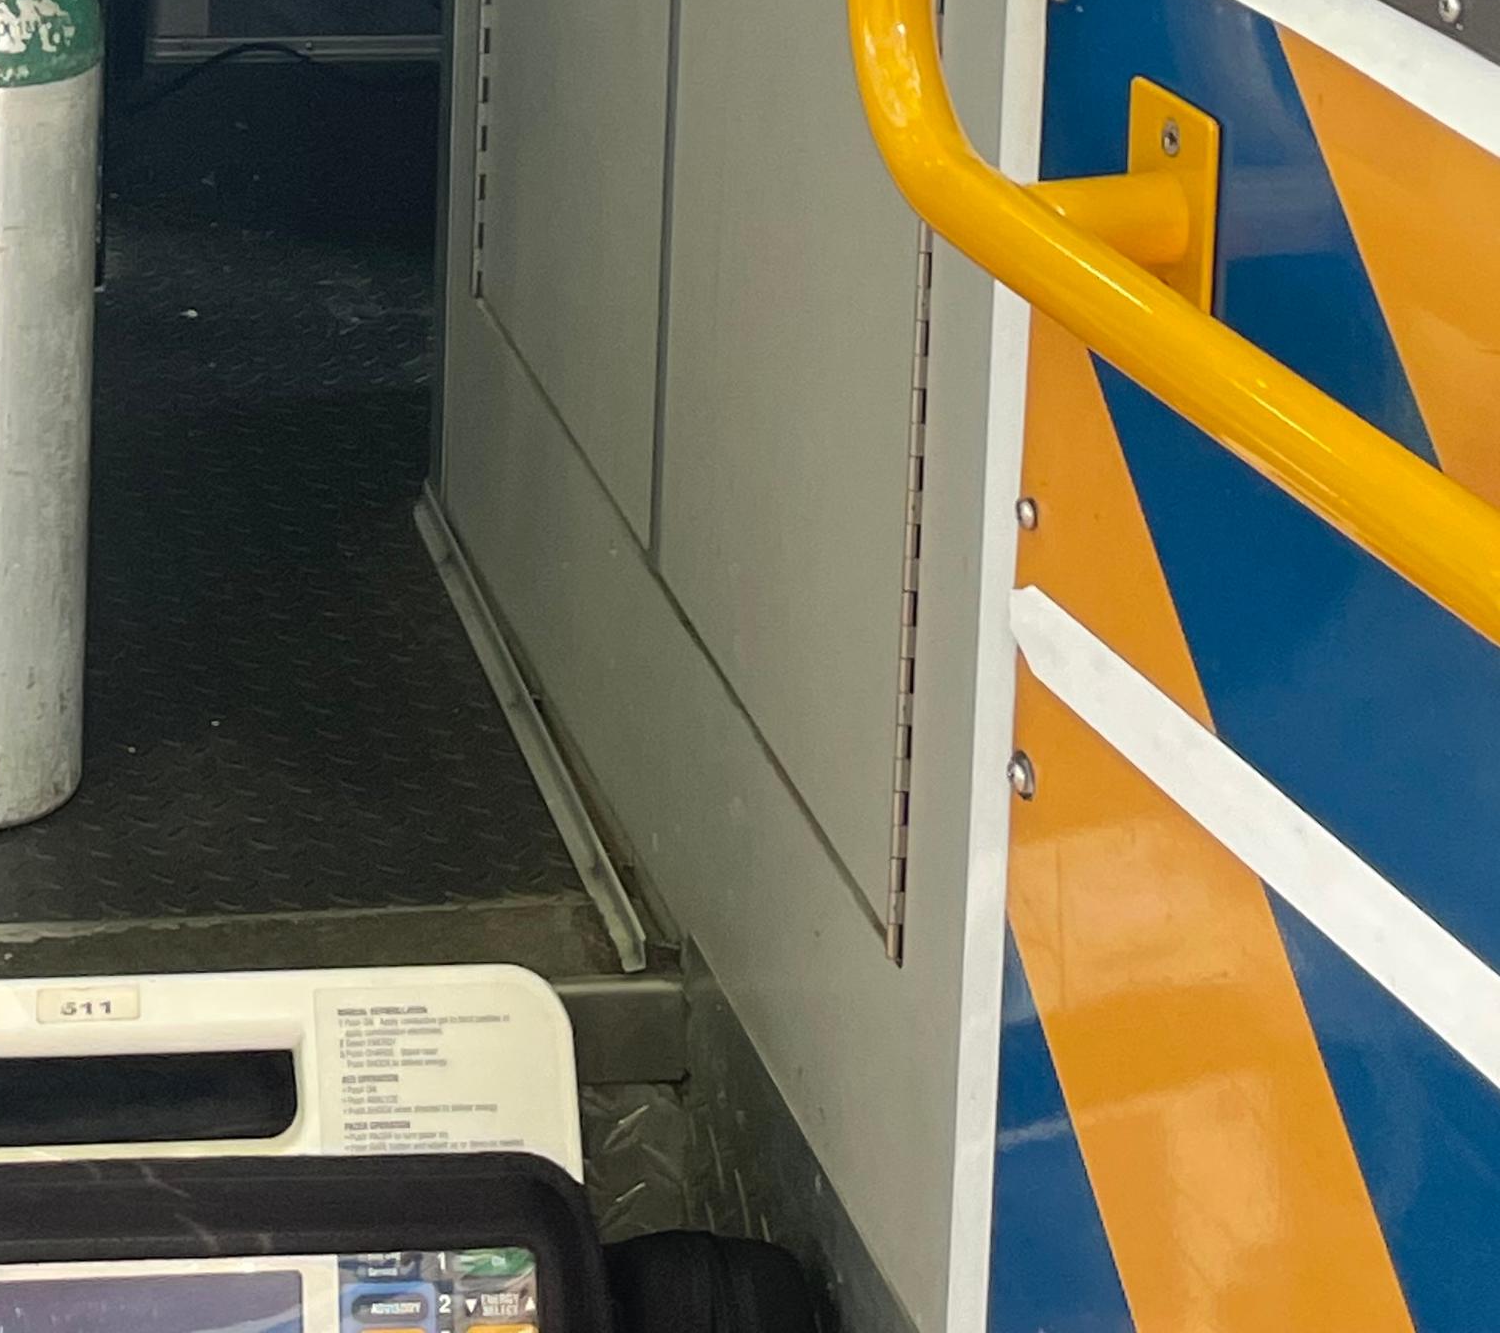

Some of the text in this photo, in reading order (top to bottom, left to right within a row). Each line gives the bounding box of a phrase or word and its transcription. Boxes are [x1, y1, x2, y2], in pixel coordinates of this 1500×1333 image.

[60, 1001, 111, 1015] 511
[437, 1252, 446, 1270] 1
[439, 1294, 451, 1314] 2
